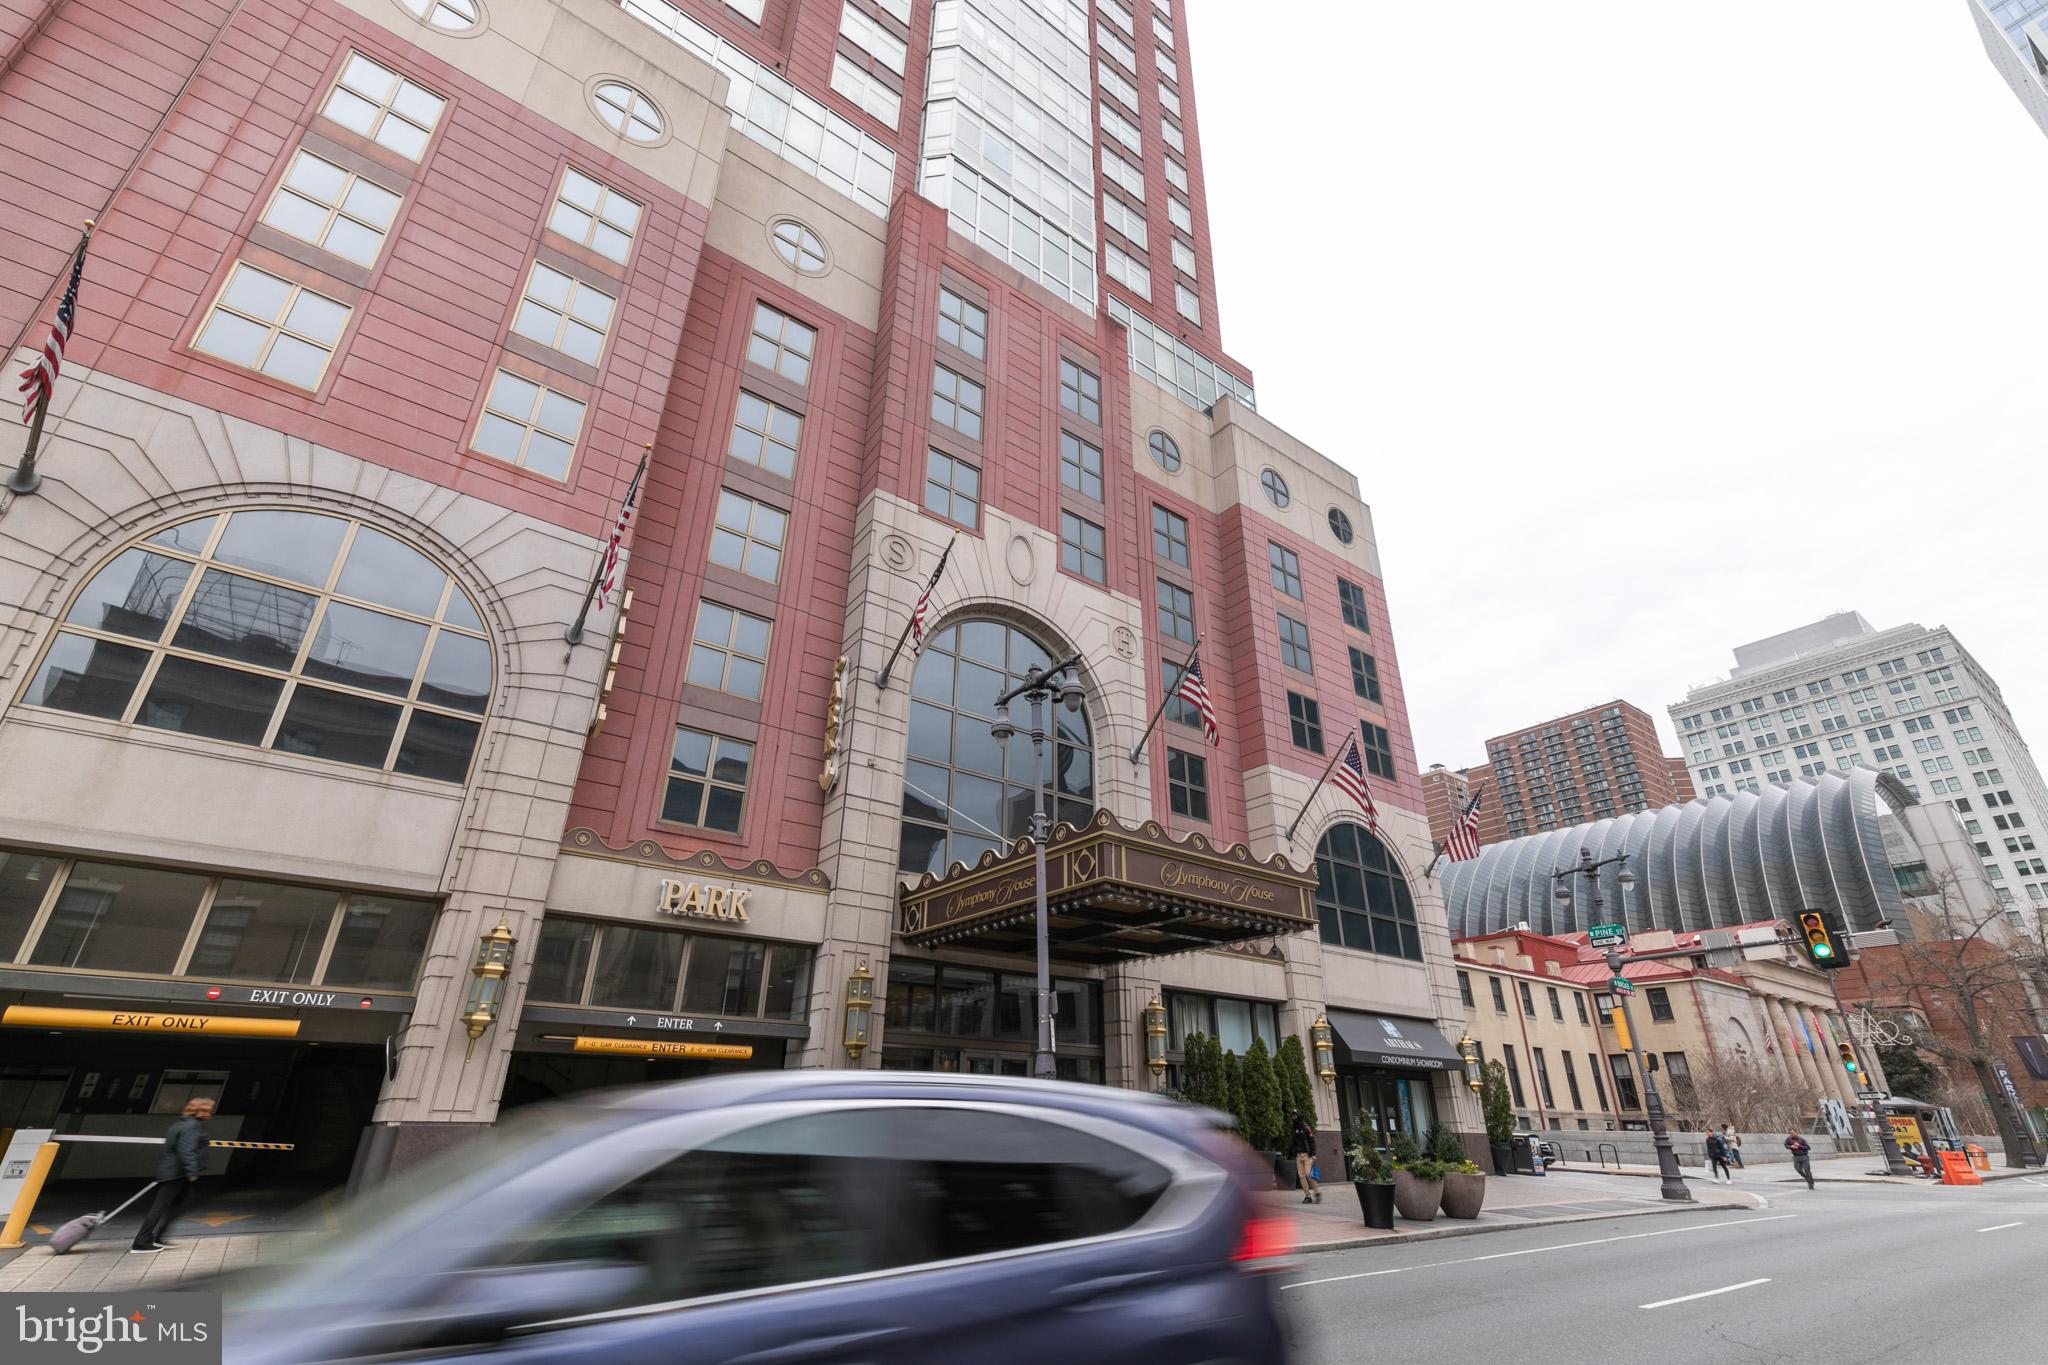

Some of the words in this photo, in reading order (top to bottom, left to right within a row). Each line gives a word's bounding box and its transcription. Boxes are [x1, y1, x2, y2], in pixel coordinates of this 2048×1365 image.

[1160, 862, 1230, 893] Symphony
[1230, 878, 1275, 902] House
[657, 879, 752, 923] PARK
[946, 888, 997, 919] Symphony
[997, 877, 1036, 905] House
[1595, 928, 1613, 937] PINE
[250, 989, 290, 1004] EXIT
[292, 992, 336, 1006] ONLY
[112, 1014, 155, 1027] EXIT
[162, 1017, 209, 1029] ONLY
[657, 1017, 694, 1030] ENTER
[651, 1043, 687, 1054] ENTER
[1887, 1118, 1915, 1126] UMBA
